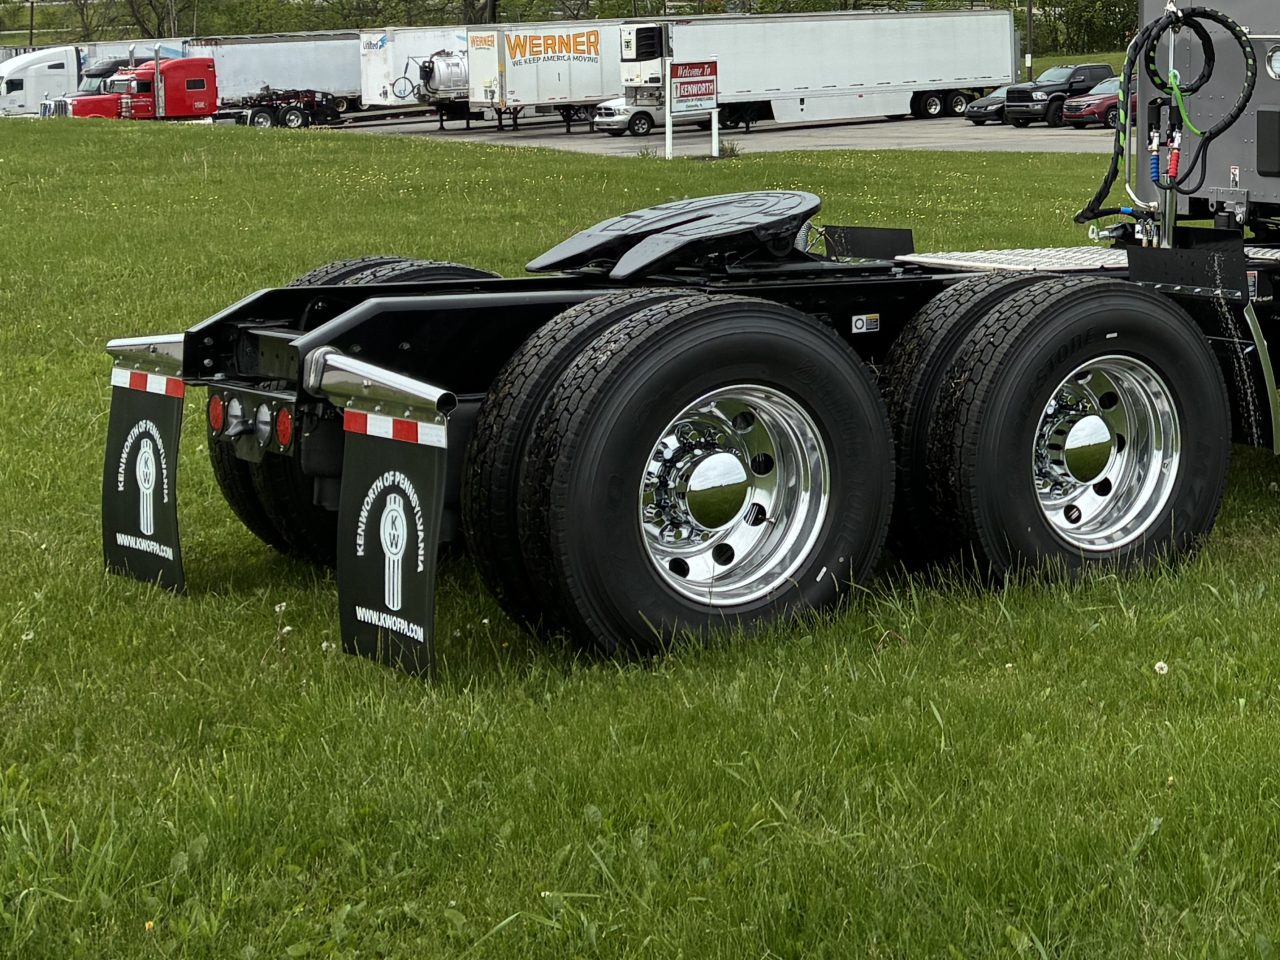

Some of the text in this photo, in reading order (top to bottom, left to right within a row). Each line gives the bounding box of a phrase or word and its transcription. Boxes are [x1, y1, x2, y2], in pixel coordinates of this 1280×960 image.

[470, 34, 495, 48] WERNER
[505, 29, 600, 60] WERNER
[511, 54, 599, 67] WE KEEP AMERICA MOVING
[678, 64, 711, 77] Welcome To
[680, 83, 714, 96] KENWORTH
[117, 419, 169, 504] KENWORTH OF PENNSYLVANIA
[356, 470, 425, 573] KENWORTH OF PENNSYLVANIA
[115, 532, 174, 561] WWW.KWOFPA.COM
[355, 605, 424, 643] WWW.KWOFPA.COM
